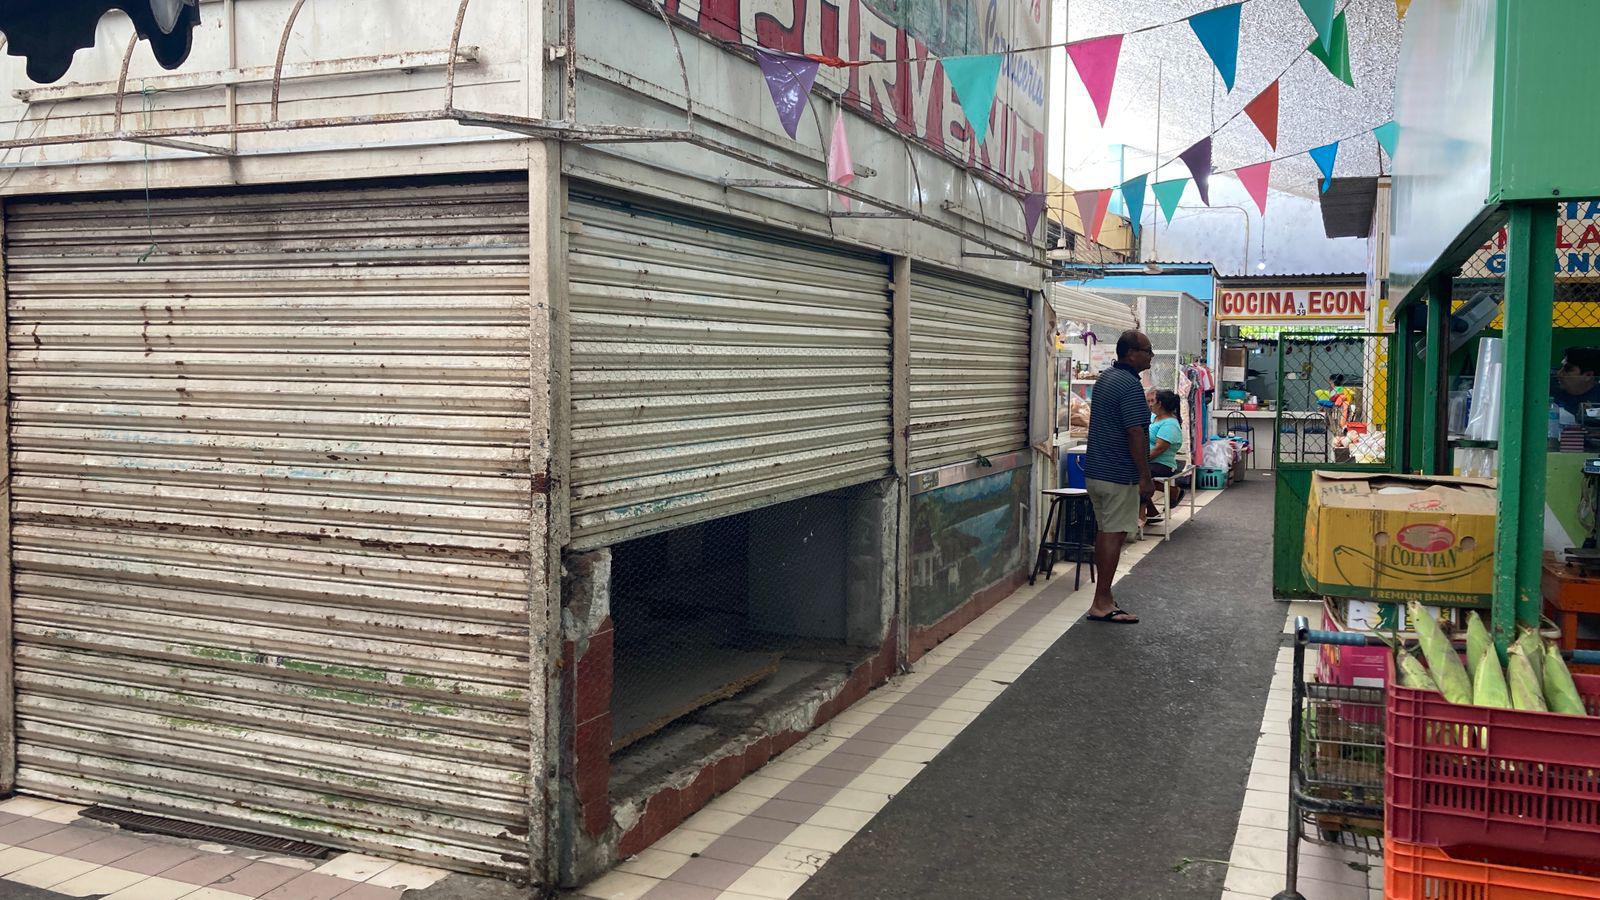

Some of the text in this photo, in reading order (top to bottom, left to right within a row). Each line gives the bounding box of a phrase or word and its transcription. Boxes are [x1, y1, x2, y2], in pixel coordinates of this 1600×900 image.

[1222, 291, 1365, 314] COCINA ECON
[1391, 544, 1457, 568] COLIMAN
[1370, 590, 1480, 604] PREMIUM BANANAS
